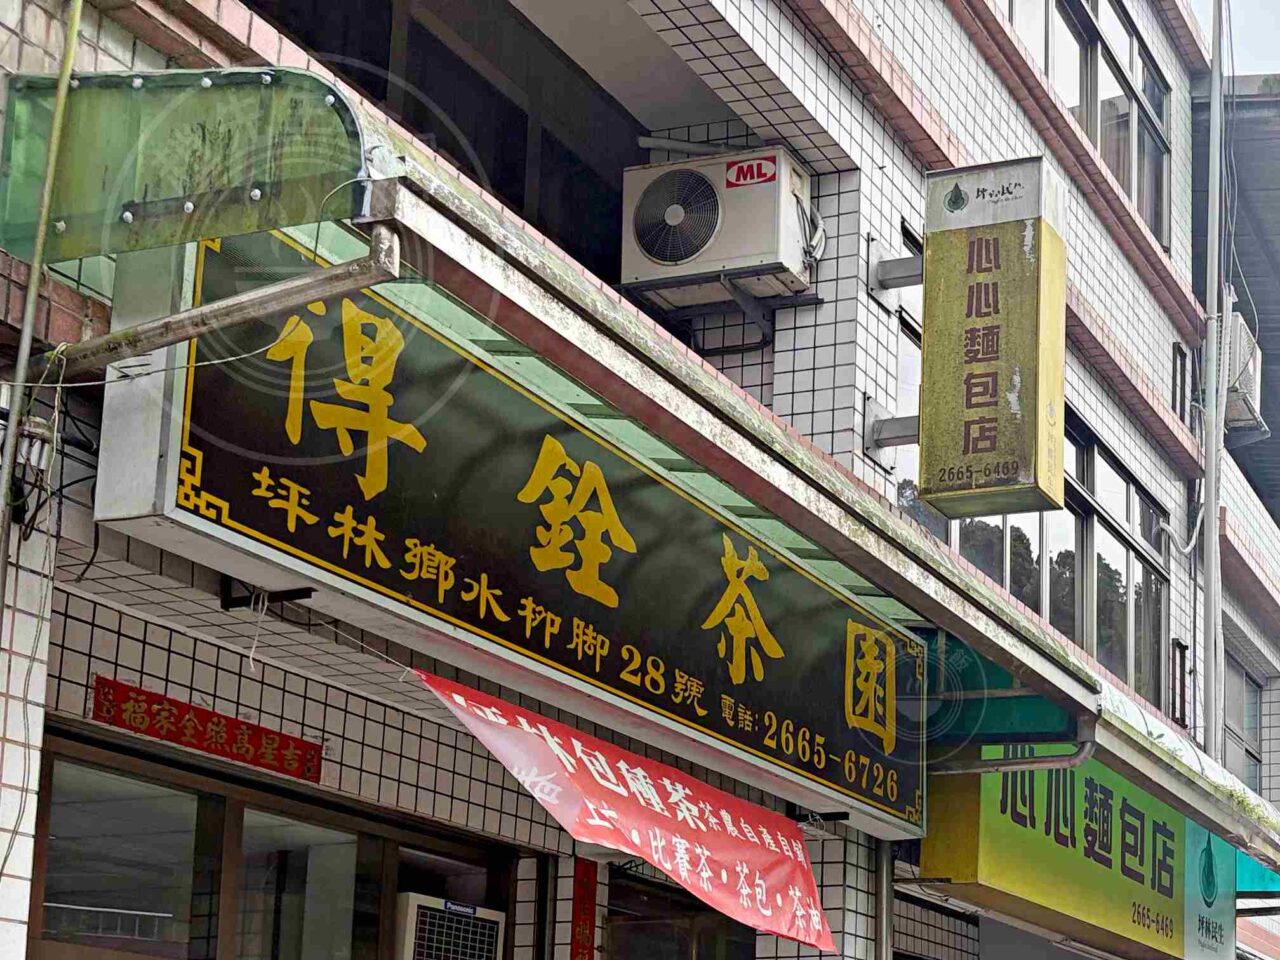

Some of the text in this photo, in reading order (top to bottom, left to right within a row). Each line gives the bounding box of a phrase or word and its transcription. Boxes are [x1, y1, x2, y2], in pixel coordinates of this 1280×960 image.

[735, 161, 769, 185] ML
[961, 234, 1001, 456] 心心麵包店
[938, 460, 1020, 484] 2665-6469
[763, 710, 899, 802] 2665-6726
[1000, 744, 1176, 900] 心心麵包店
[1131, 901, 1174, 940] 2665-6469
